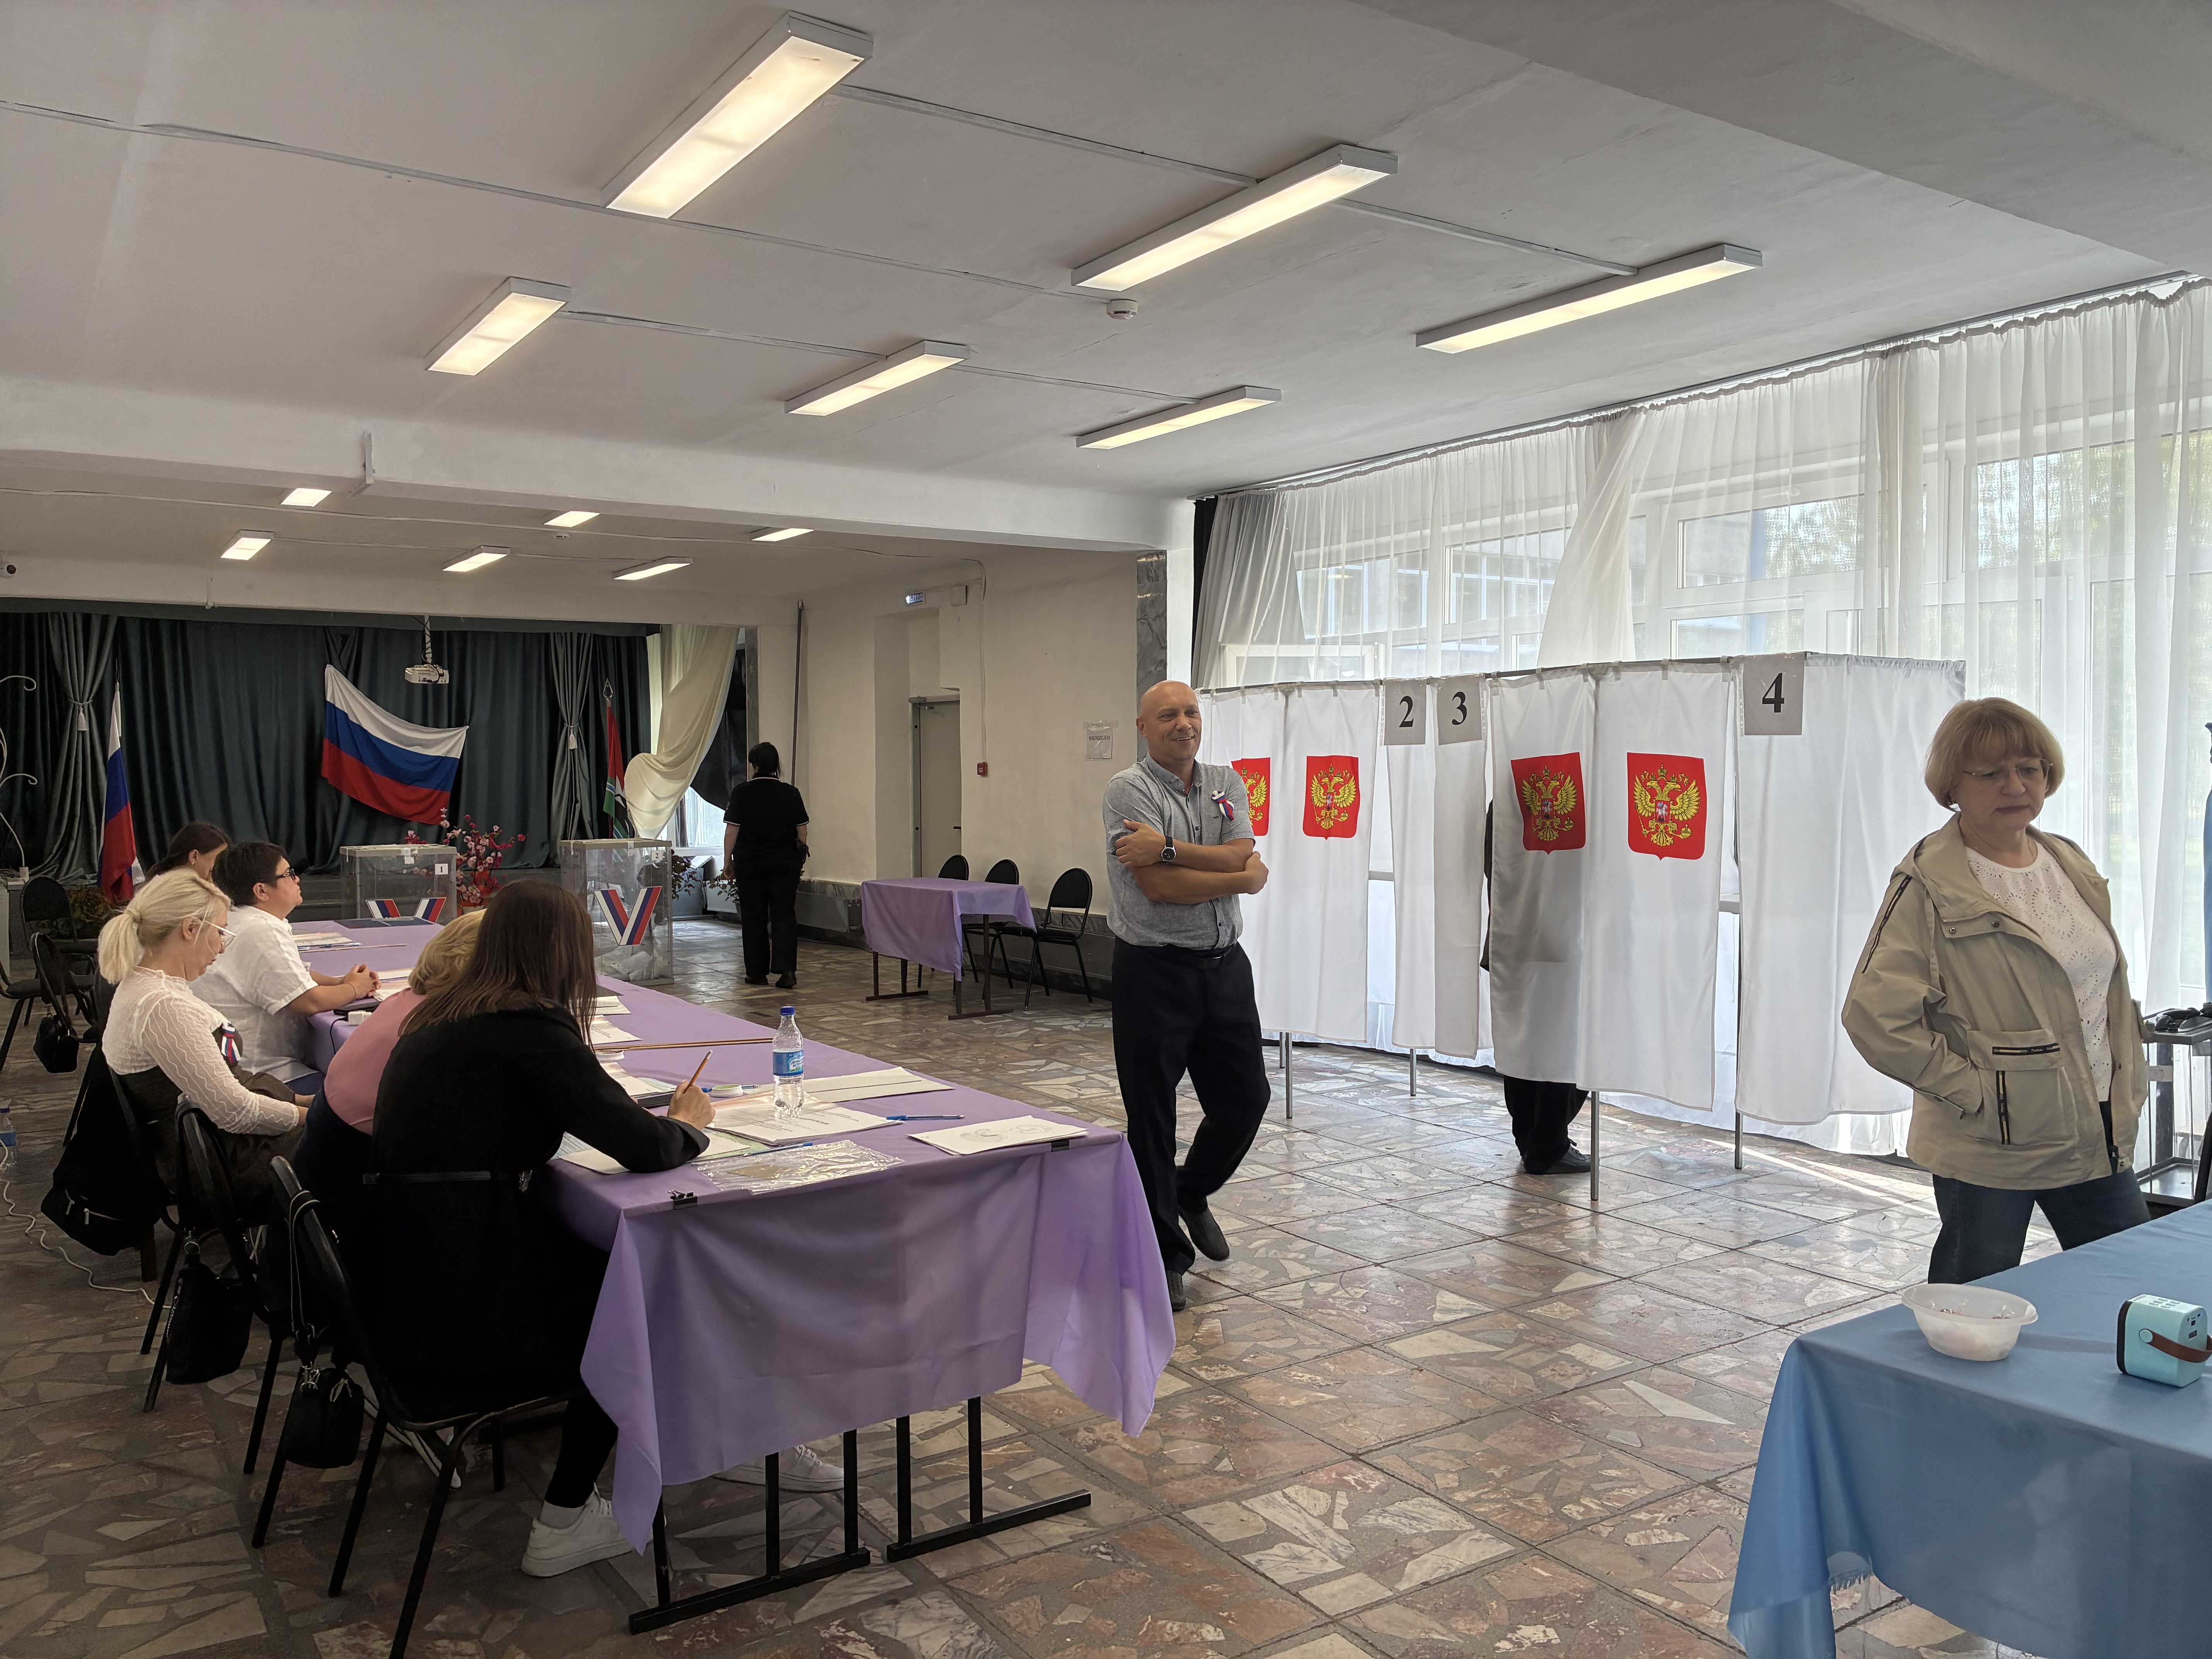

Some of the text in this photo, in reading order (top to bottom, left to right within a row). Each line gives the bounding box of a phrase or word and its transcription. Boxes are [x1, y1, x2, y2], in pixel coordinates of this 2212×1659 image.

[905, 594, 923, 604] ВЫХОД
[1452, 691, 1467, 725] 3
[1762, 673, 1784, 713] 4
[1399, 696, 1414, 728] 2
